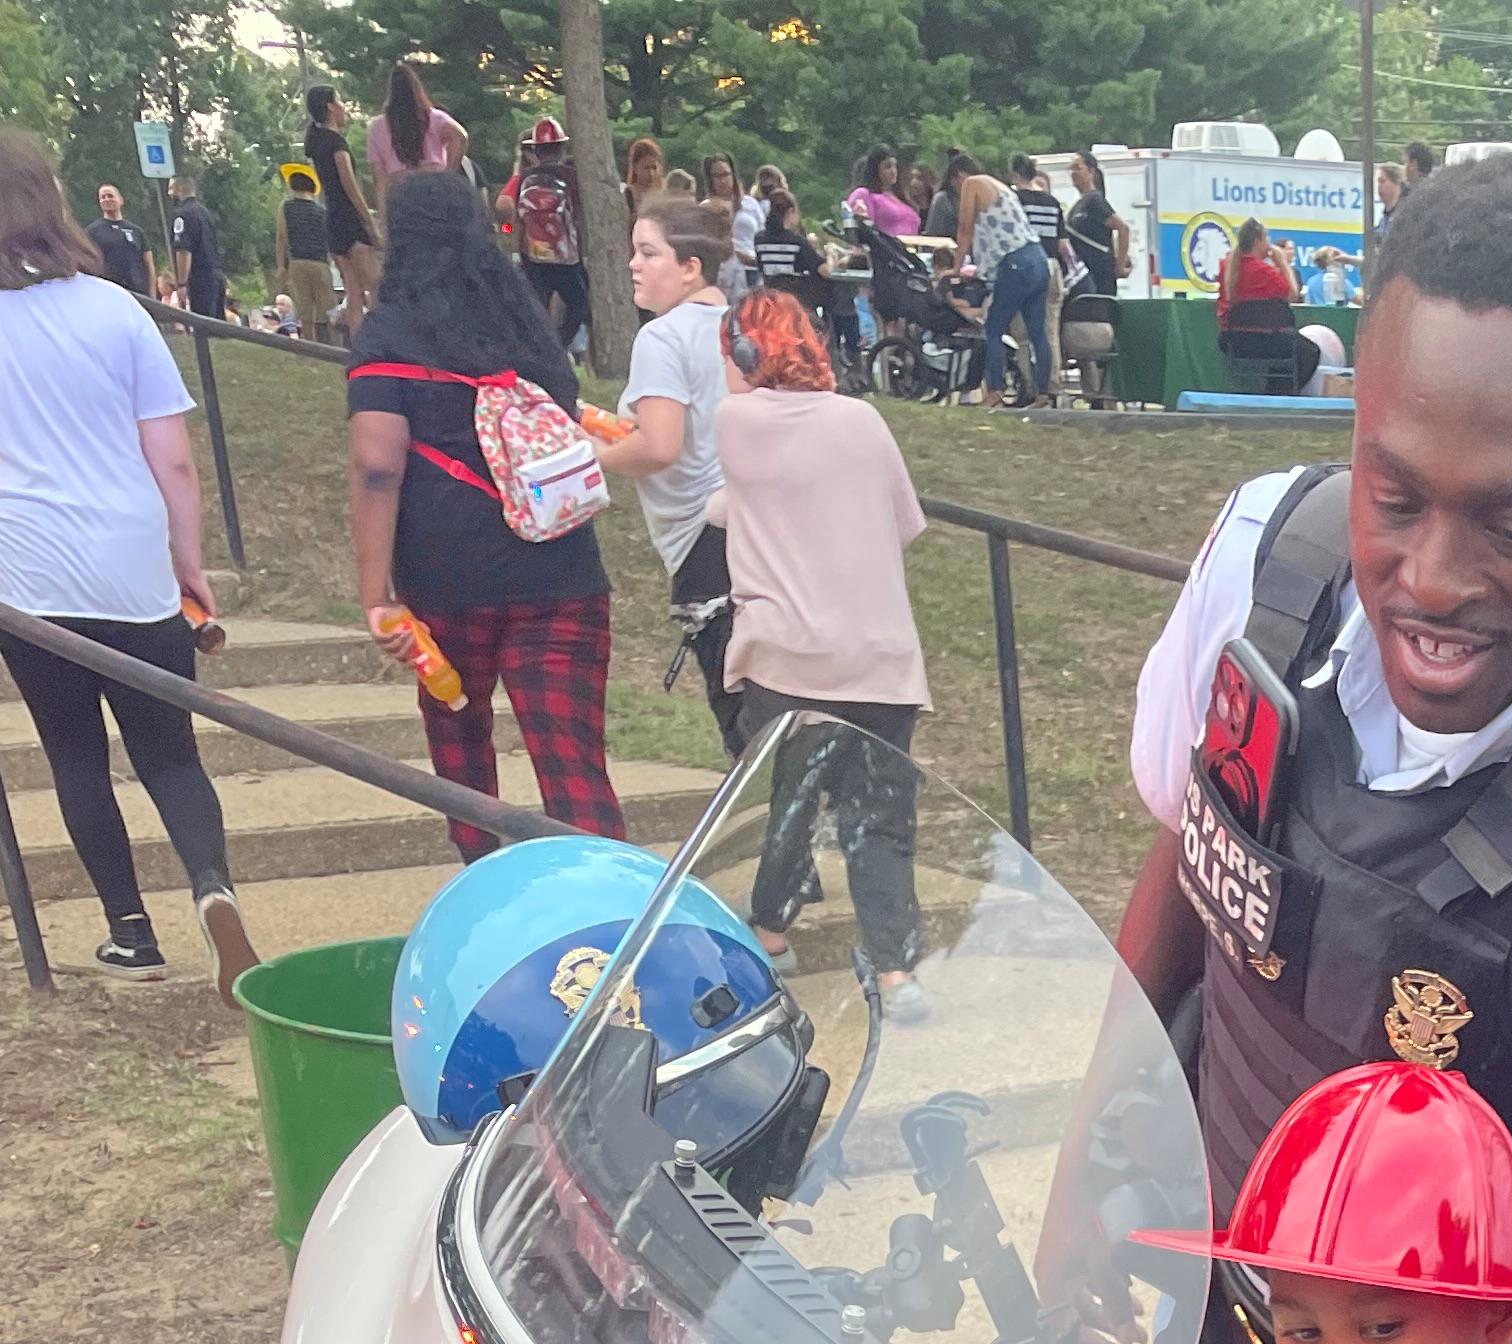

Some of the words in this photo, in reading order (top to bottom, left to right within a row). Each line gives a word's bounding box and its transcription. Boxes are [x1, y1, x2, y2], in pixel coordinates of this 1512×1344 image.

[1211, 177, 1266, 204] Lions
[1272, 181, 1347, 209] District
[1201, 803, 1272, 897] PARK
